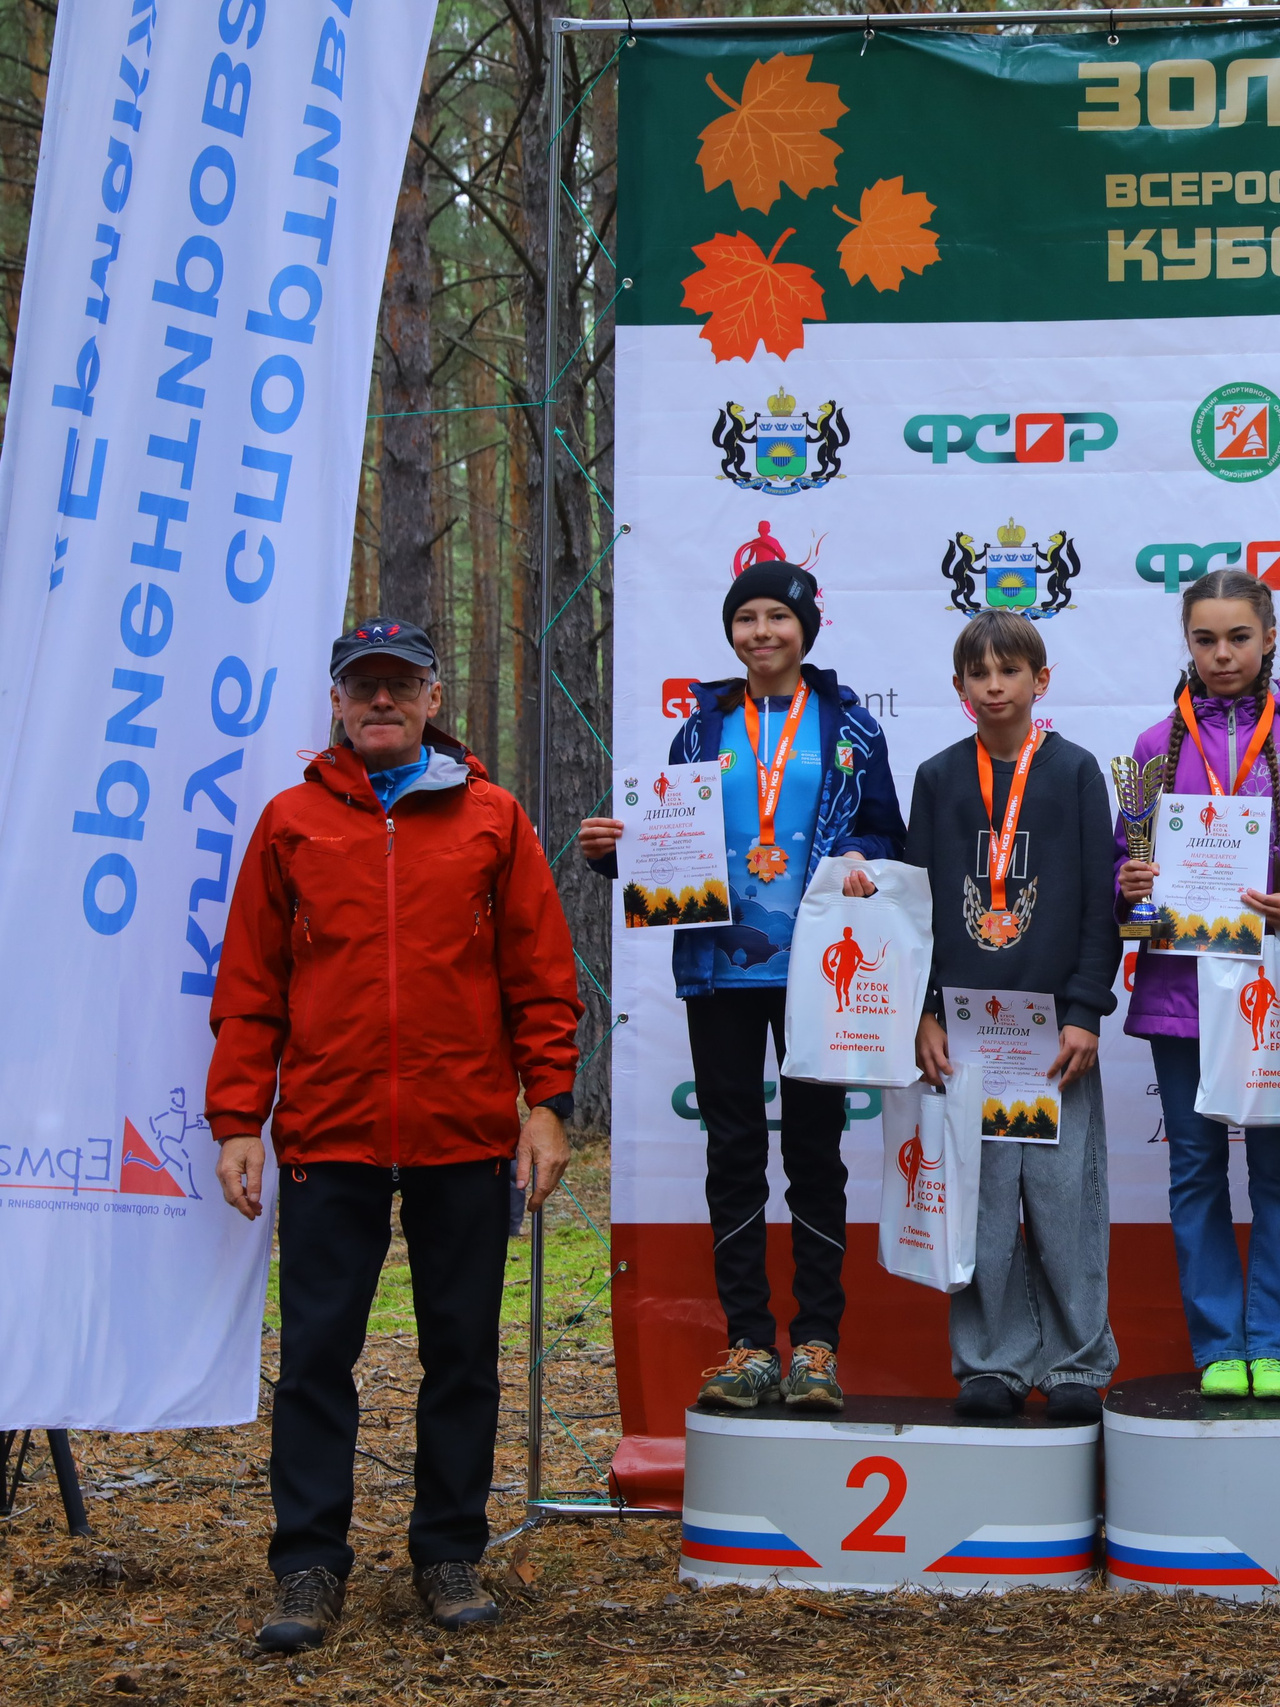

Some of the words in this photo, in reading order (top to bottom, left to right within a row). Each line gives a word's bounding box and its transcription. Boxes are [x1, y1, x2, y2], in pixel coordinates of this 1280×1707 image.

[1196, 396, 1219, 434] ФЕДЕРАЦИЯ
[1221, 386, 1271, 401] СПОРТИВНОГО
[1196, 439, 1216, 468] ОБЛАСТИ
[1219, 468, 1263, 478] ТЮМЕНСКОЙ
[764, 789, 776, 816] КУБОК
[770, 771, 780, 787] КСО
[776, 736, 789, 768] «ЕРМАК»
[790, 687, 806, 719] ТЮМЕНЬ
[644, 807, 696, 821] ДИПЛОМ
[995, 852, 1007, 880] КУБОК
[1001, 833, 1011, 850] КСО
[1006, 795, 1018, 831] «ЕРМАК»
[1018, 743, 1033, 775] ТЮМЕНЬ
[1186, 838, 1241, 849] ДИПЛОМ
[771, 851, 780, 861] 2
[1002, 915, 1012, 926] 2
[856, 982, 889, 992] КУБОК
[856, 994, 878, 1003] КСО
[849, 1006, 897, 1015] «ЕРМАК»
[835, 1030, 880, 1040] г.Тюмень
[977, 1026, 1031, 1037] ДИПЛОМ
[830, 1042, 885, 1052] orienteer.ru
[918, 1179, 946, 1192] КУБОК
[918, 1192, 934, 1201] КСО
[913, 1202, 946, 1215] «ЕРМАК
[903, 1225, 931, 1238] г.Тюмень
[899, 1236, 934, 1251] orienteer.ru
[841, 1456, 908, 1553] 2
